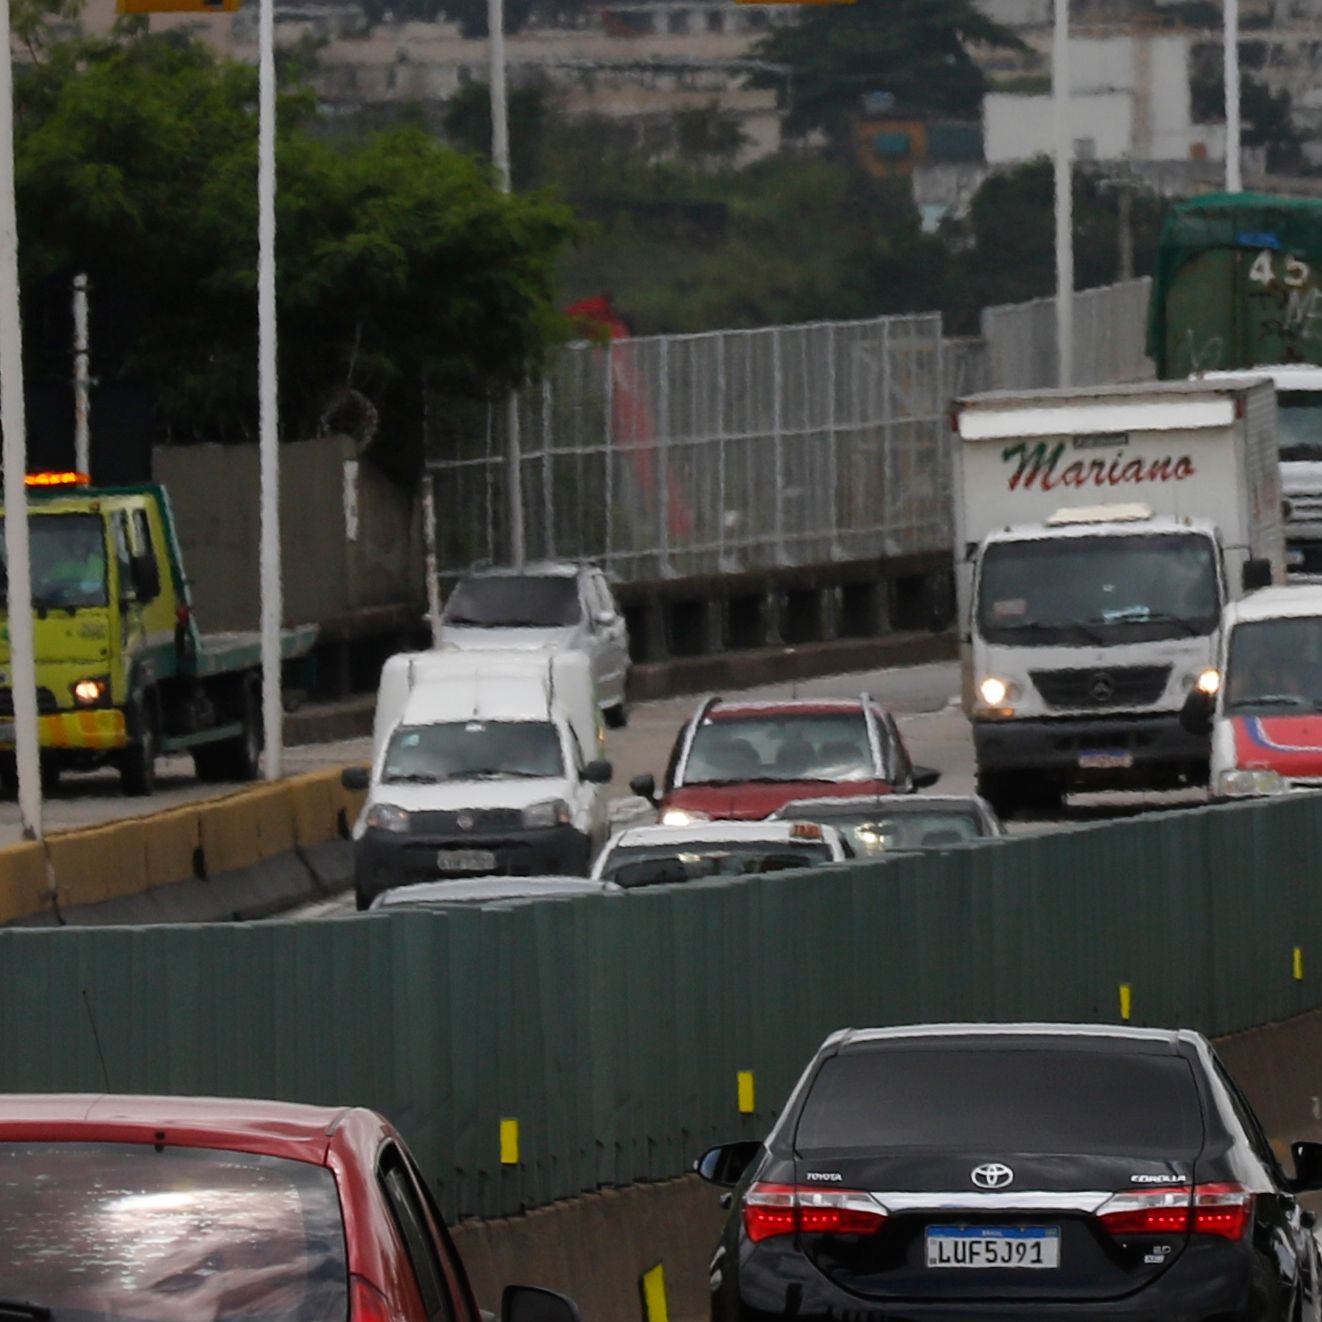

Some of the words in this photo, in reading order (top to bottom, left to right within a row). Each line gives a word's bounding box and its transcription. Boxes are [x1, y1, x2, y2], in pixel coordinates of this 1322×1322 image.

[1249, 250, 1310, 287] 45
[1001, 441, 1197, 492] Mariano
[806, 1172, 842, 1182] TOYOTA
[1130, 1174, 1187, 1183] COROLLA
[938, 1241, 1043, 1265] LUF5J91
